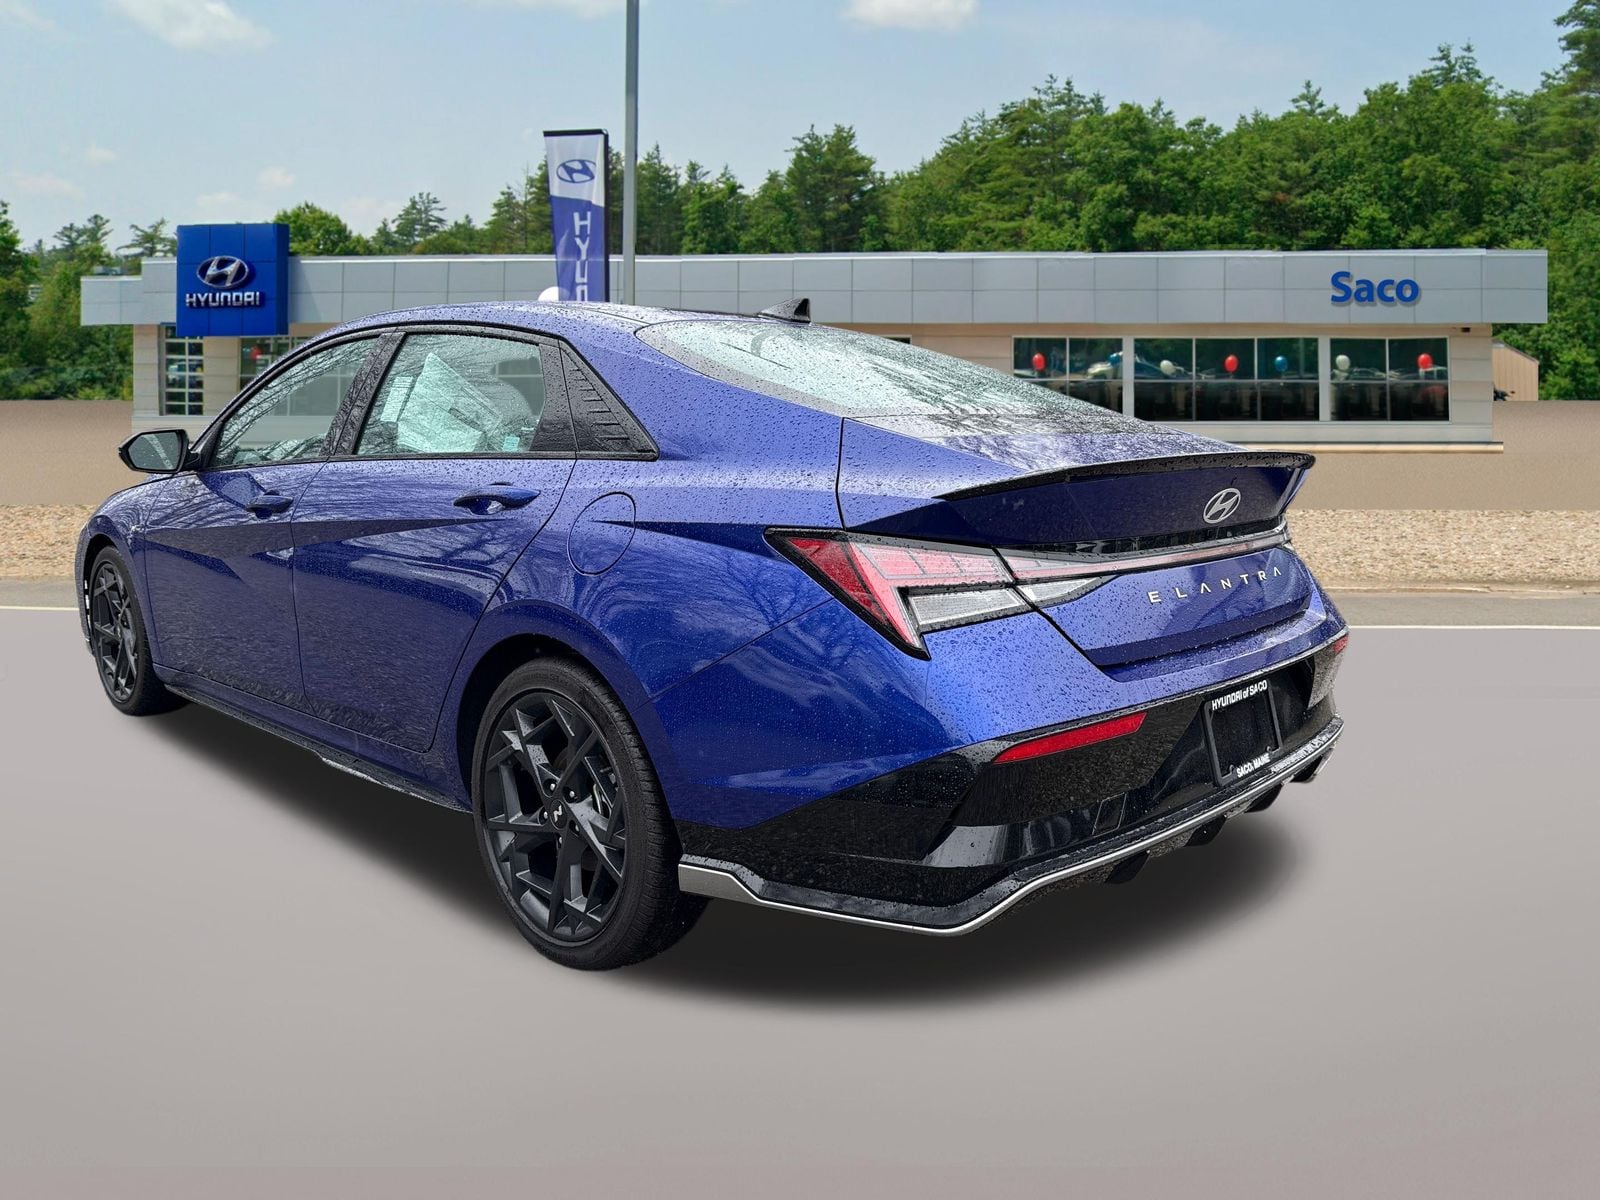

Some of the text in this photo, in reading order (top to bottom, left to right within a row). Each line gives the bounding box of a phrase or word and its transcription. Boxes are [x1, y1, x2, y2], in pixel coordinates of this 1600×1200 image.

[185, 291, 260, 307] HYUNDAI
[1330, 270, 1419, 303] Saco
[1147, 566, 1282, 603] ELANTRA
[1211, 680, 1267, 711] HYUNDAI of SACO
